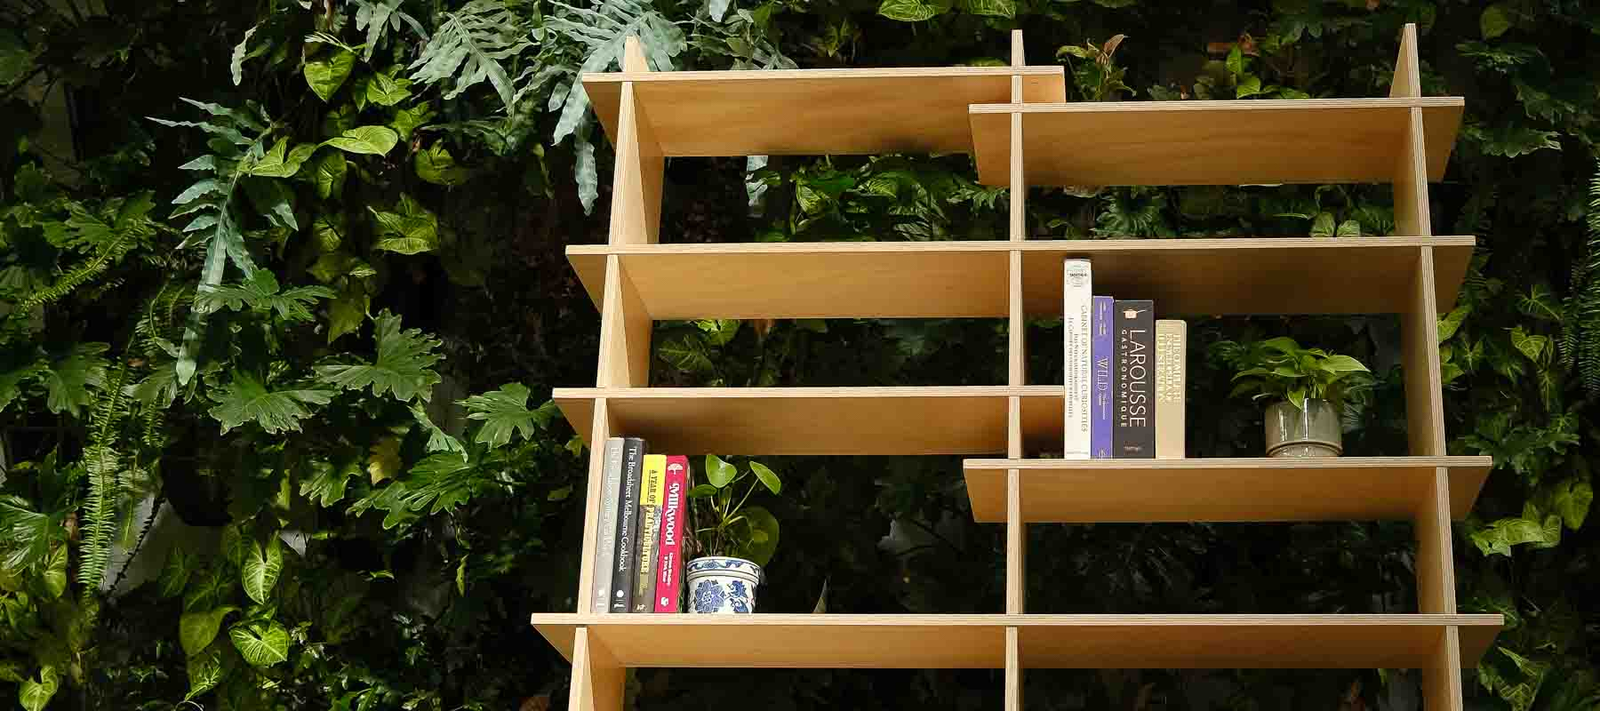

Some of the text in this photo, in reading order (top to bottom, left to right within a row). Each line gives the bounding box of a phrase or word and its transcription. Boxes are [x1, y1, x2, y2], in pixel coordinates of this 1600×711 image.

[1097, 358, 1108, 391] WILD
[1129, 330, 1146, 427] LAROUSSE
[619, 446, 637, 572] The Broadsheet Melbourne Cookbook
[649, 494, 656, 503] OF
[665, 482, 680, 546] Milkwood
